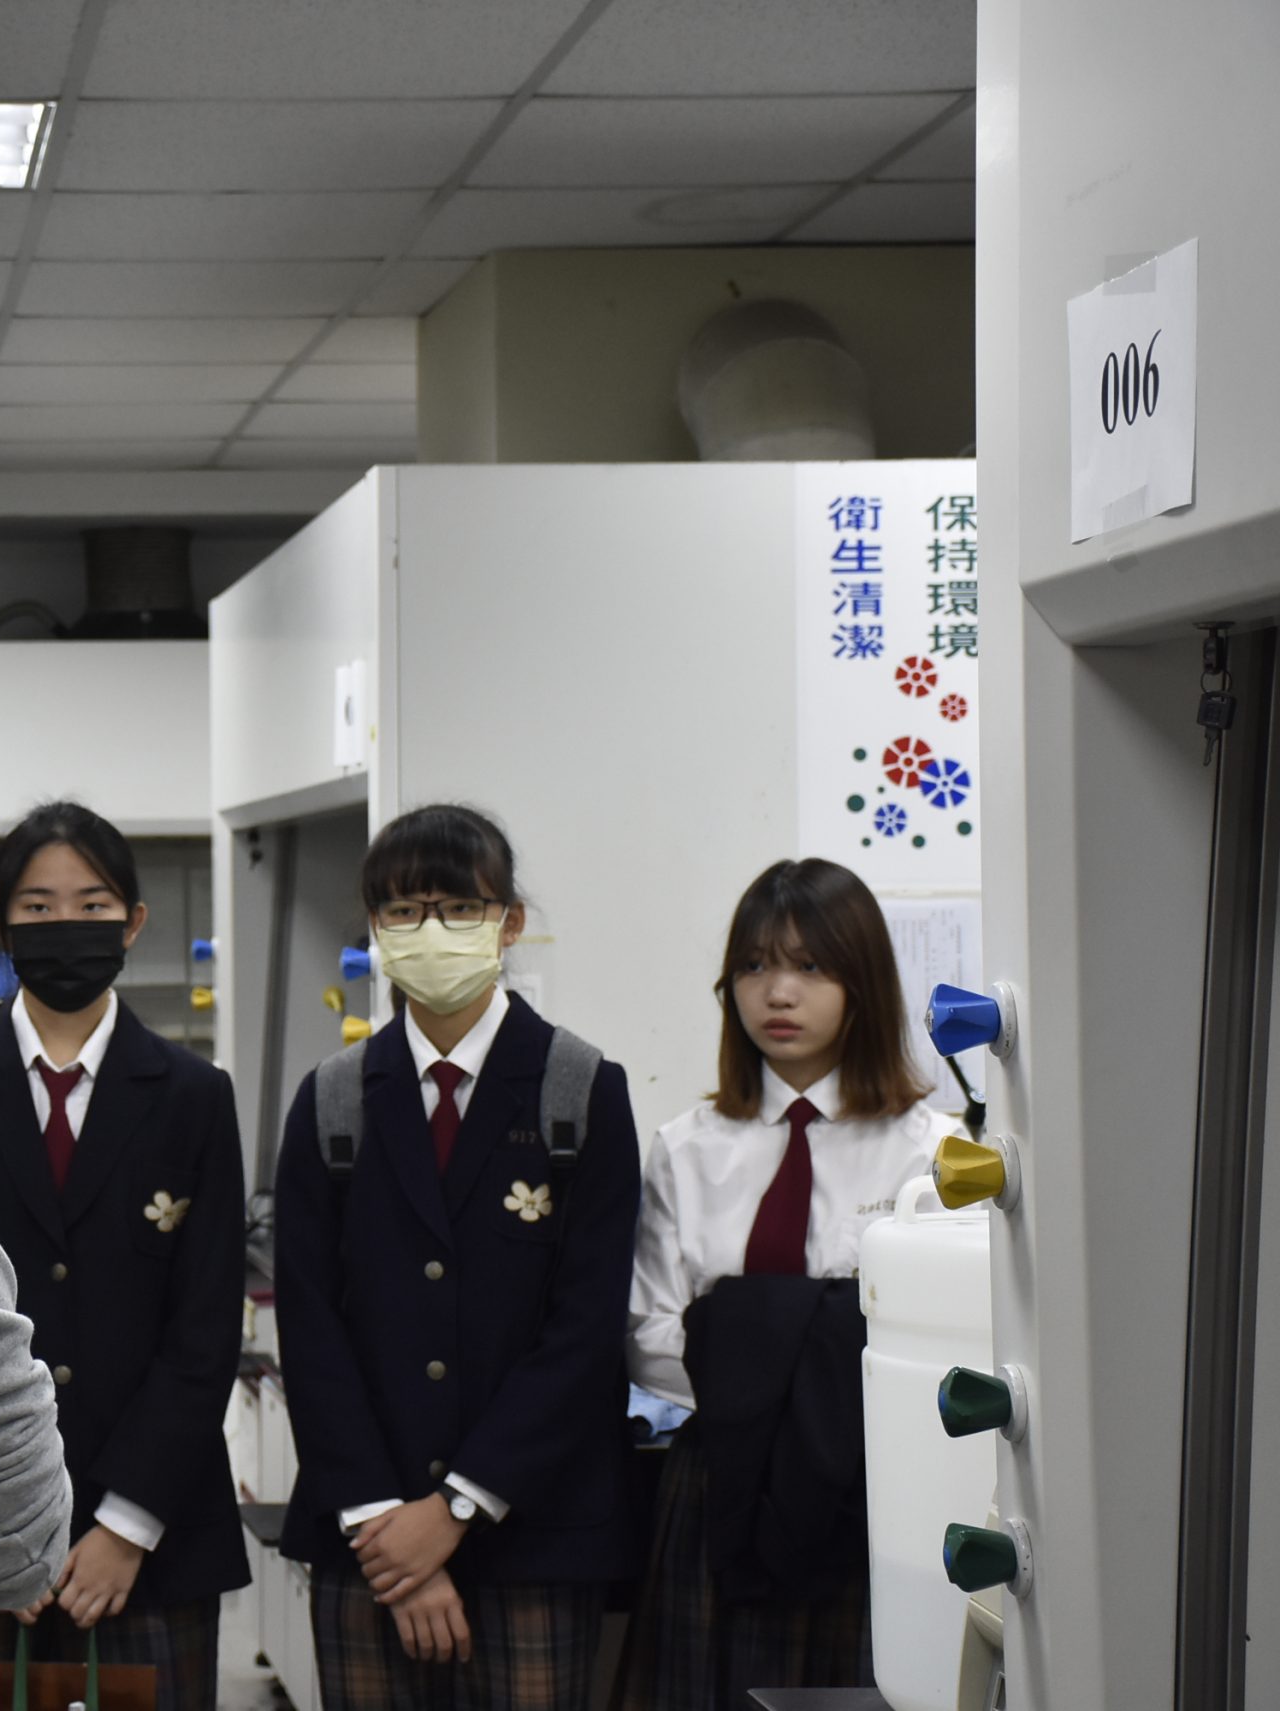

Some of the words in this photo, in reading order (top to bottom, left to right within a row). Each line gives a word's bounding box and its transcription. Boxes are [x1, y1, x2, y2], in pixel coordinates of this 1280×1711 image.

[1101, 328, 1162, 434] 006
[829, 495, 883, 660] 衛生清潔
[925, 494, 978, 659] 保持環境
